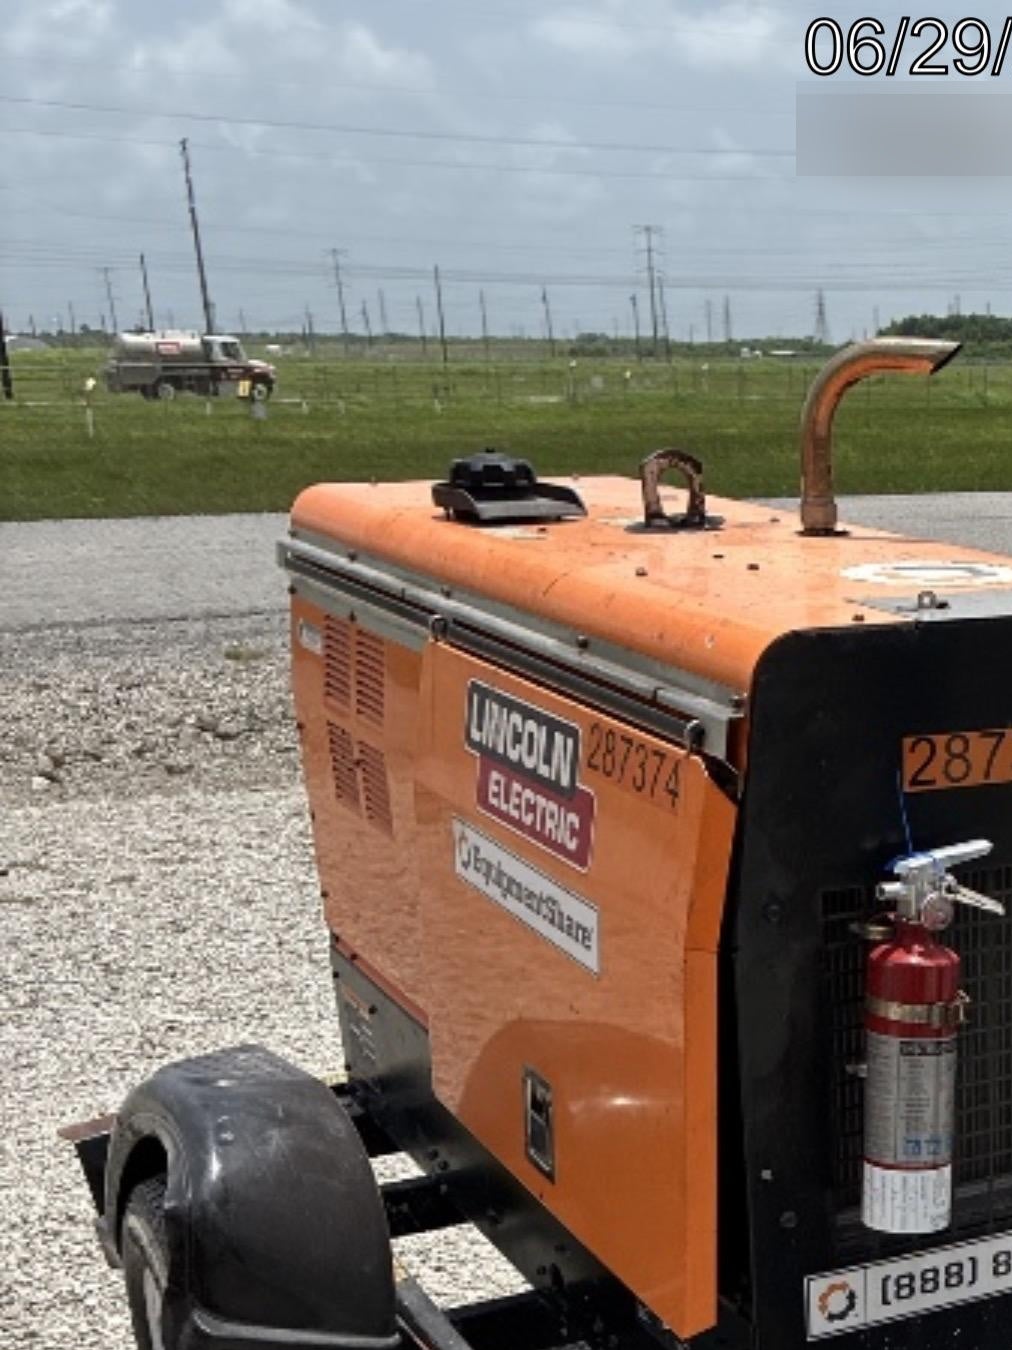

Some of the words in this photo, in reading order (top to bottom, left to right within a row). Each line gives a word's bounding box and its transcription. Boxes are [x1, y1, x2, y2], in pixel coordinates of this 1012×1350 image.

[470, 692, 574, 788] LINCOLN
[586, 722, 682, 808] 287374
[488, 769, 581, 852] ELECTRIC
[473, 844, 593, 951] EquipmentShare
[880, 1256, 978, 1306] (888)
